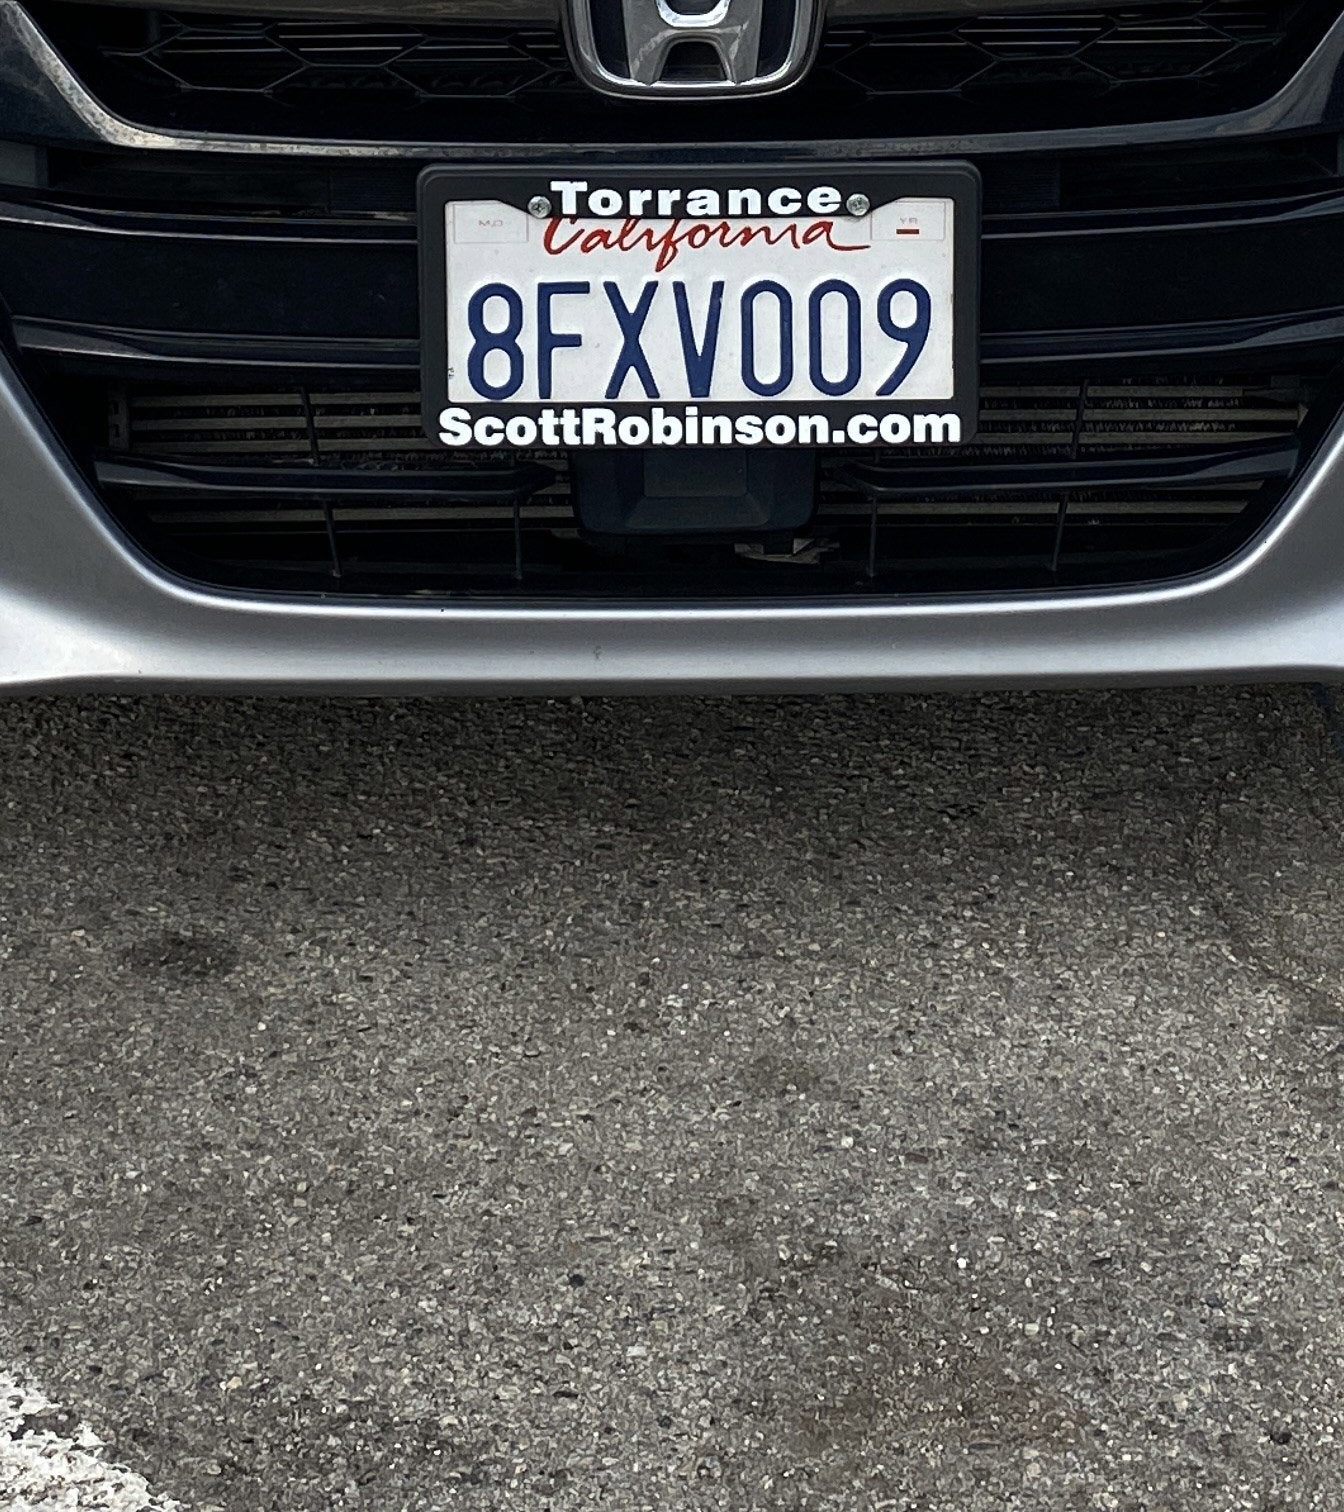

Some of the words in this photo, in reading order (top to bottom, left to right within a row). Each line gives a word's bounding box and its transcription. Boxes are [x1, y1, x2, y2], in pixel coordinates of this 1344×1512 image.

[550, 180, 843, 217] Torrance
[543, 216, 871, 273] California
[466, 278, 932, 401] 8FXV009
[438, 406, 962, 447] ScottRobinson.com
